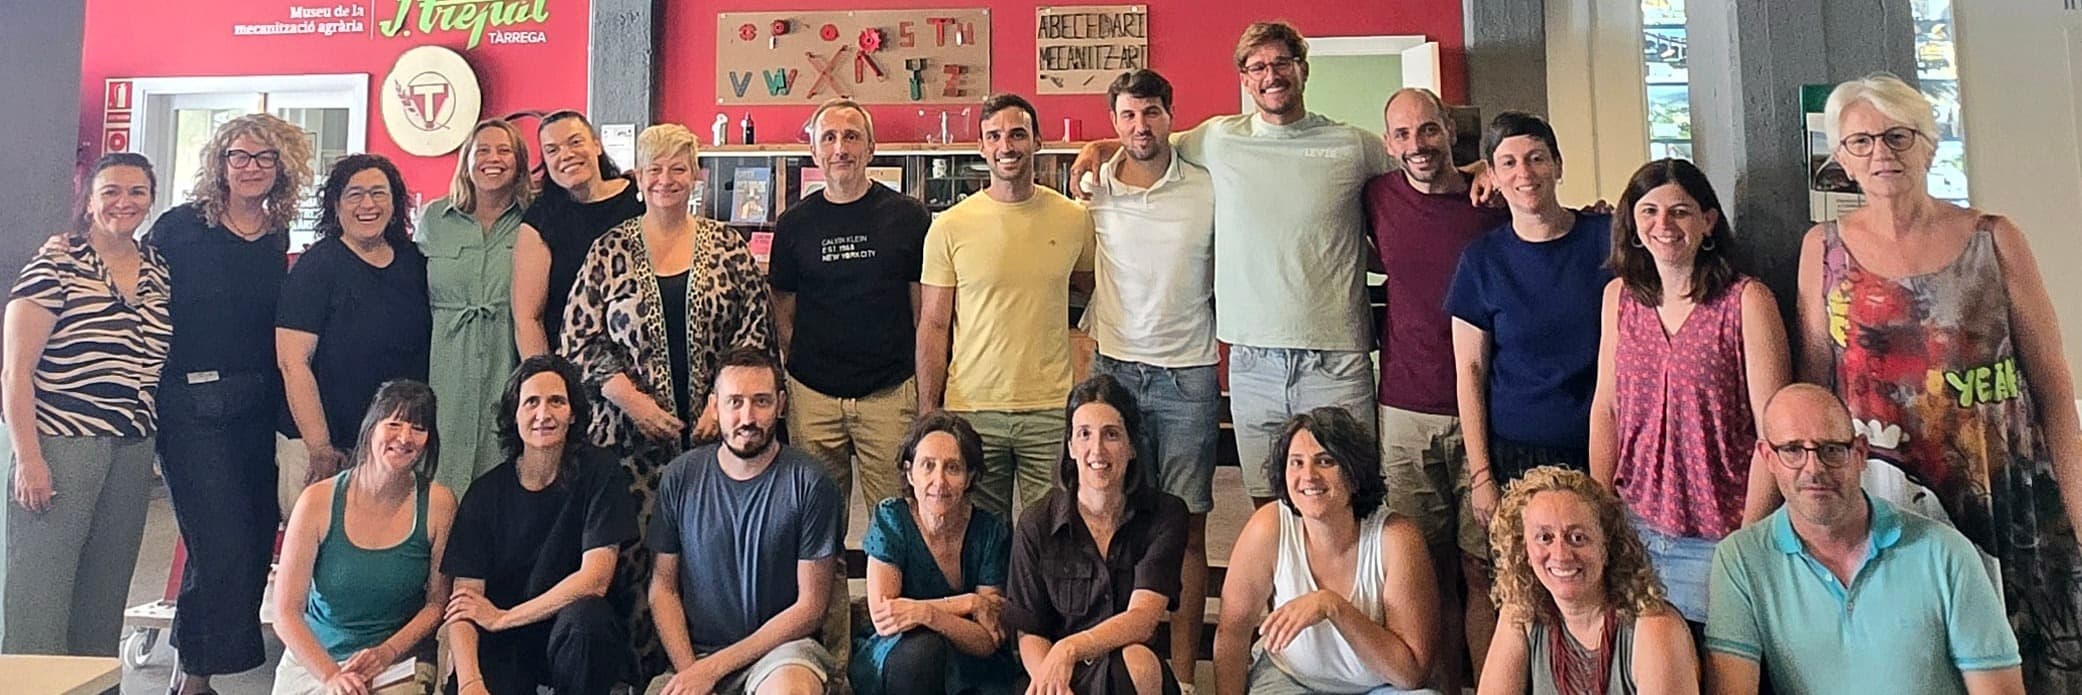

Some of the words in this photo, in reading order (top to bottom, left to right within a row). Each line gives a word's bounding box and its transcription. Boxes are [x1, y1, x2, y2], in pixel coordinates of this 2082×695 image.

[289, 6, 332, 18] Museu
[334, 5, 350, 17] de
[352, 4, 365, 17] la
[234, 20, 315, 35] mecanització
[317, 20, 364, 36] agrària
[926, 17, 956, 47] T
[488, 31, 547, 45] TÀRREGA
[729, 71, 752, 97] V
[805, 45, 849, 99] X
